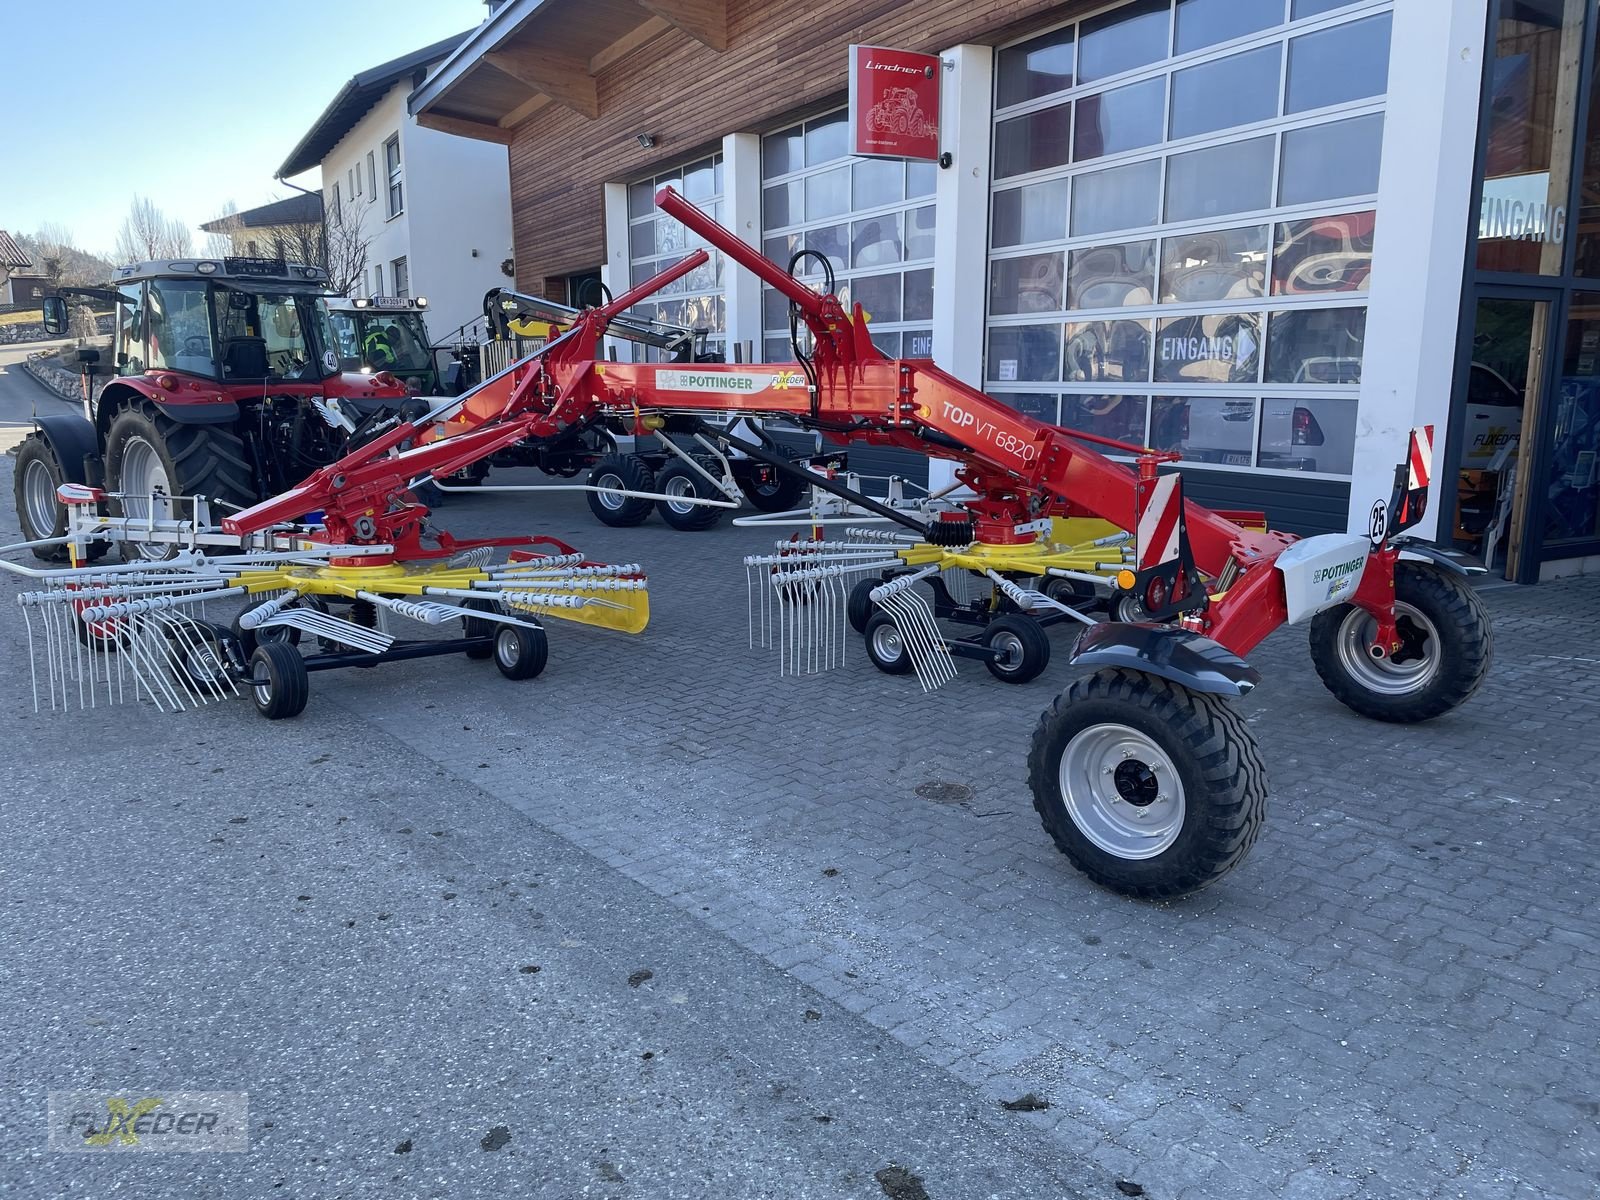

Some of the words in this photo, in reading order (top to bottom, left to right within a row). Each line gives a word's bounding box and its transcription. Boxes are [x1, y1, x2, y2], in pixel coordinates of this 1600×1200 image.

[864, 60, 922, 74] Lindner
[912, 336, 933, 355] EINF
[1161, 335, 1233, 361] EINGANG
[327, 353, 337, 368] 40
[943, 401, 974, 427] TOP
[976, 418, 997, 440] VT
[995, 431, 1035, 461] 6820
[1372, 506, 1385, 538] 25
